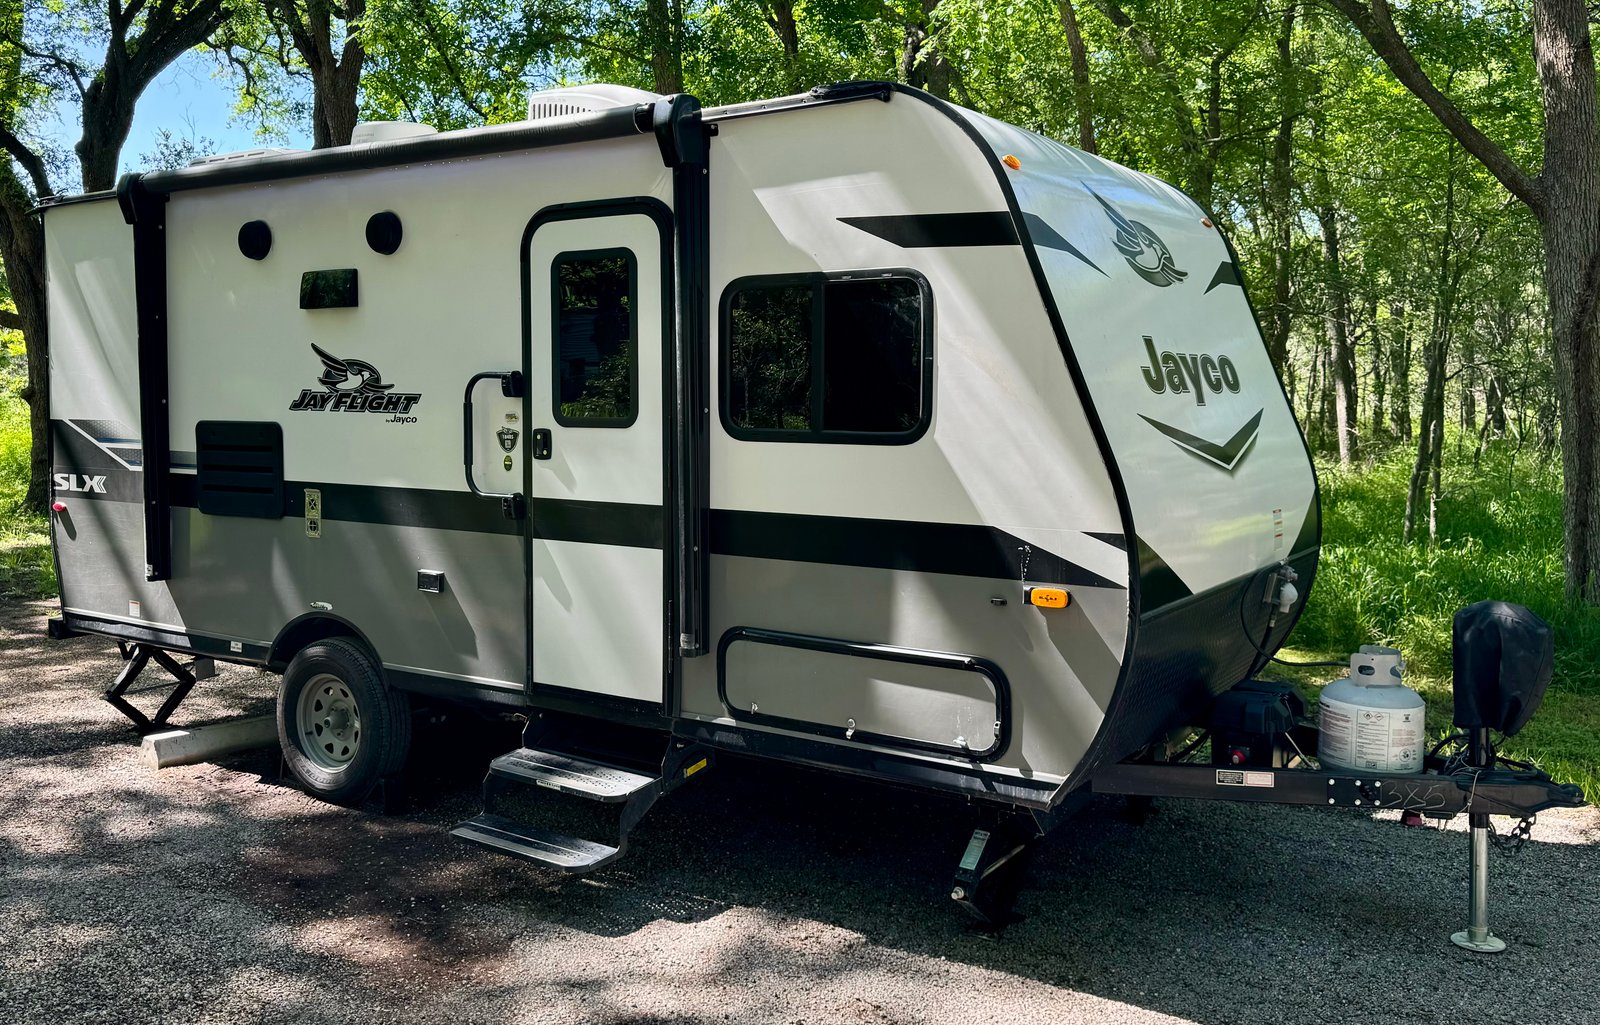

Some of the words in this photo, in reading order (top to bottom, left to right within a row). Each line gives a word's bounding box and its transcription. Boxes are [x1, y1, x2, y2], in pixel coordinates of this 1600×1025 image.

[1140, 335, 1241, 406] Jayco
[289, 389, 337, 411] JAY
[329, 391, 422, 414] FLIGHT
[390, 414, 418, 425] Jayco
[53, 473, 107, 493] SLX
